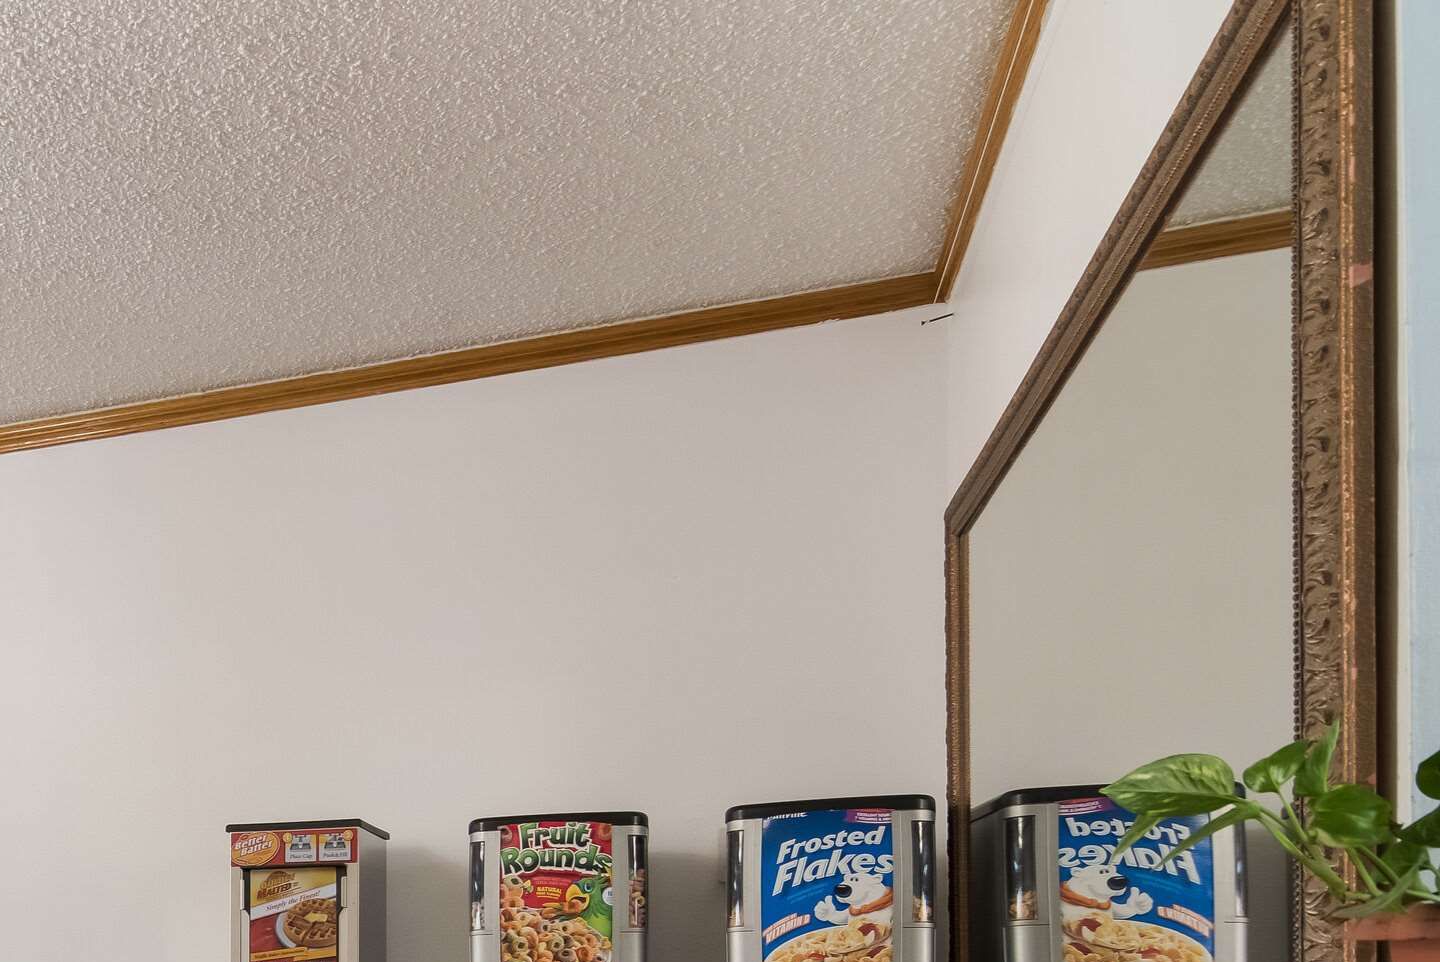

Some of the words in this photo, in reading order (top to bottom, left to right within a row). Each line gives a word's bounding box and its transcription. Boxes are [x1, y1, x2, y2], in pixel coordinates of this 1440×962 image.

[518, 821, 593, 849] Fruit
[776, 825, 886, 865] Frosted
[499, 843, 613, 879] Rounds
[771, 848, 893, 897] Flakes
